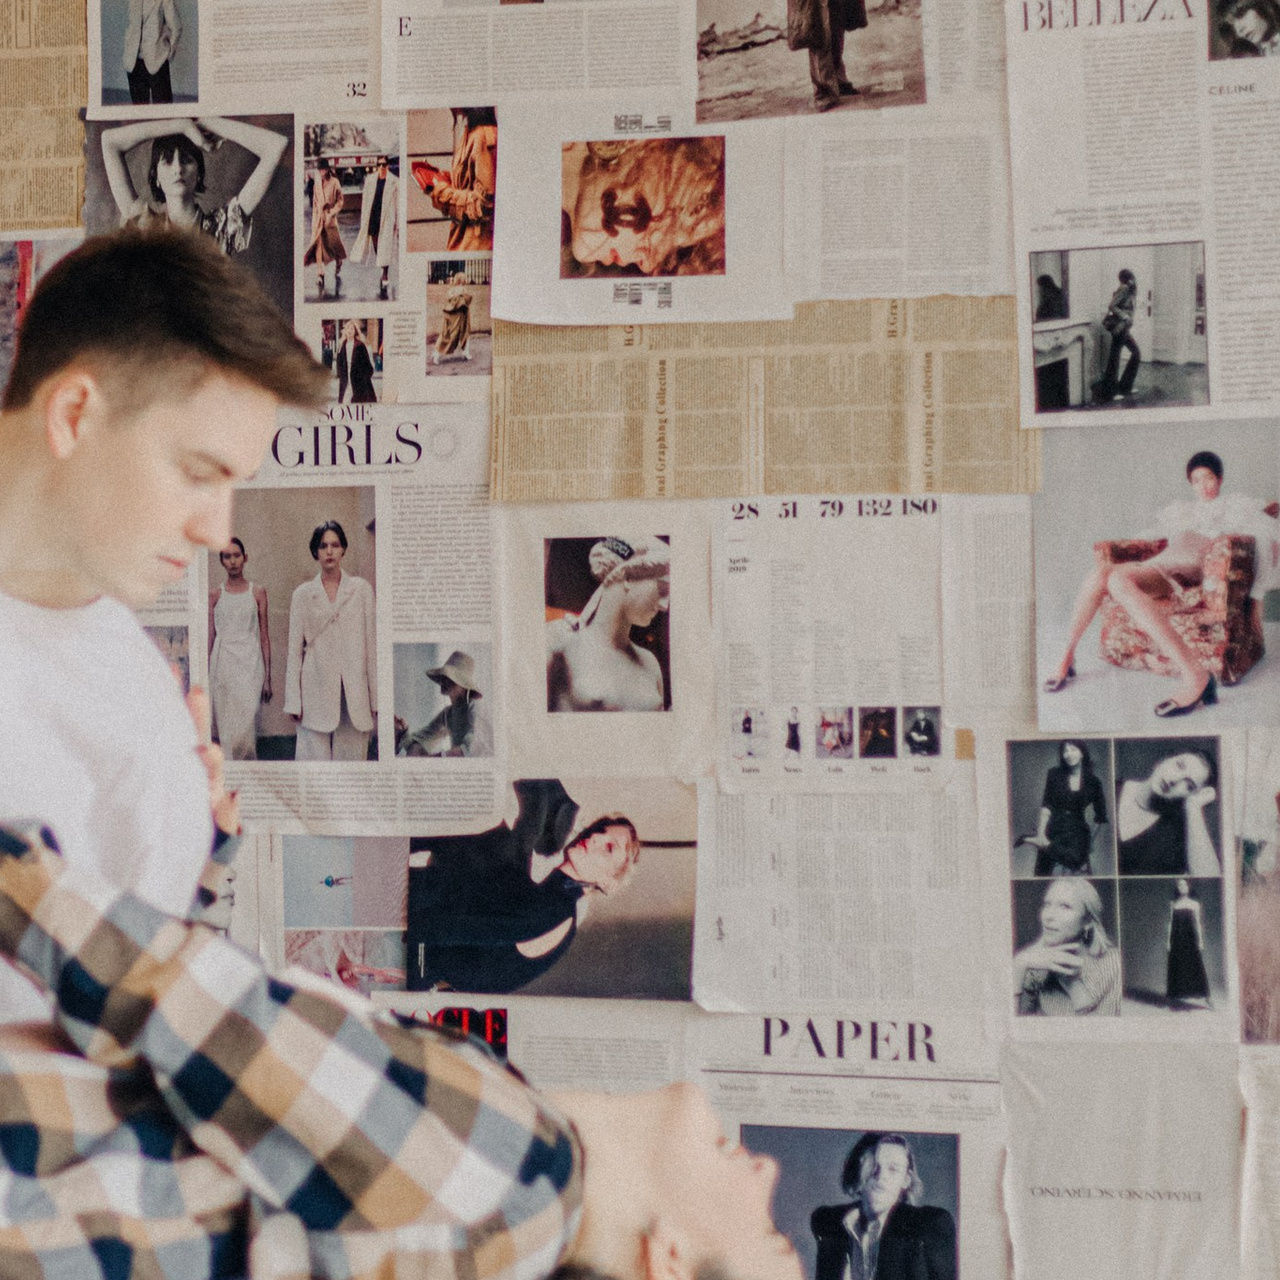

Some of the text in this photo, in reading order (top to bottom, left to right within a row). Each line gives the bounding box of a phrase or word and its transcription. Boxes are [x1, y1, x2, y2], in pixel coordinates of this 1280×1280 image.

[346, 82, 367, 98] 32
[271, 422, 423, 469] GIRLS
[731, 502, 760, 521] 28
[820, 499, 845, 518] 79
[857, 499, 893, 517] 132
[901, 498, 938, 516] 180
[763, 1017, 937, 1063] PAPER
